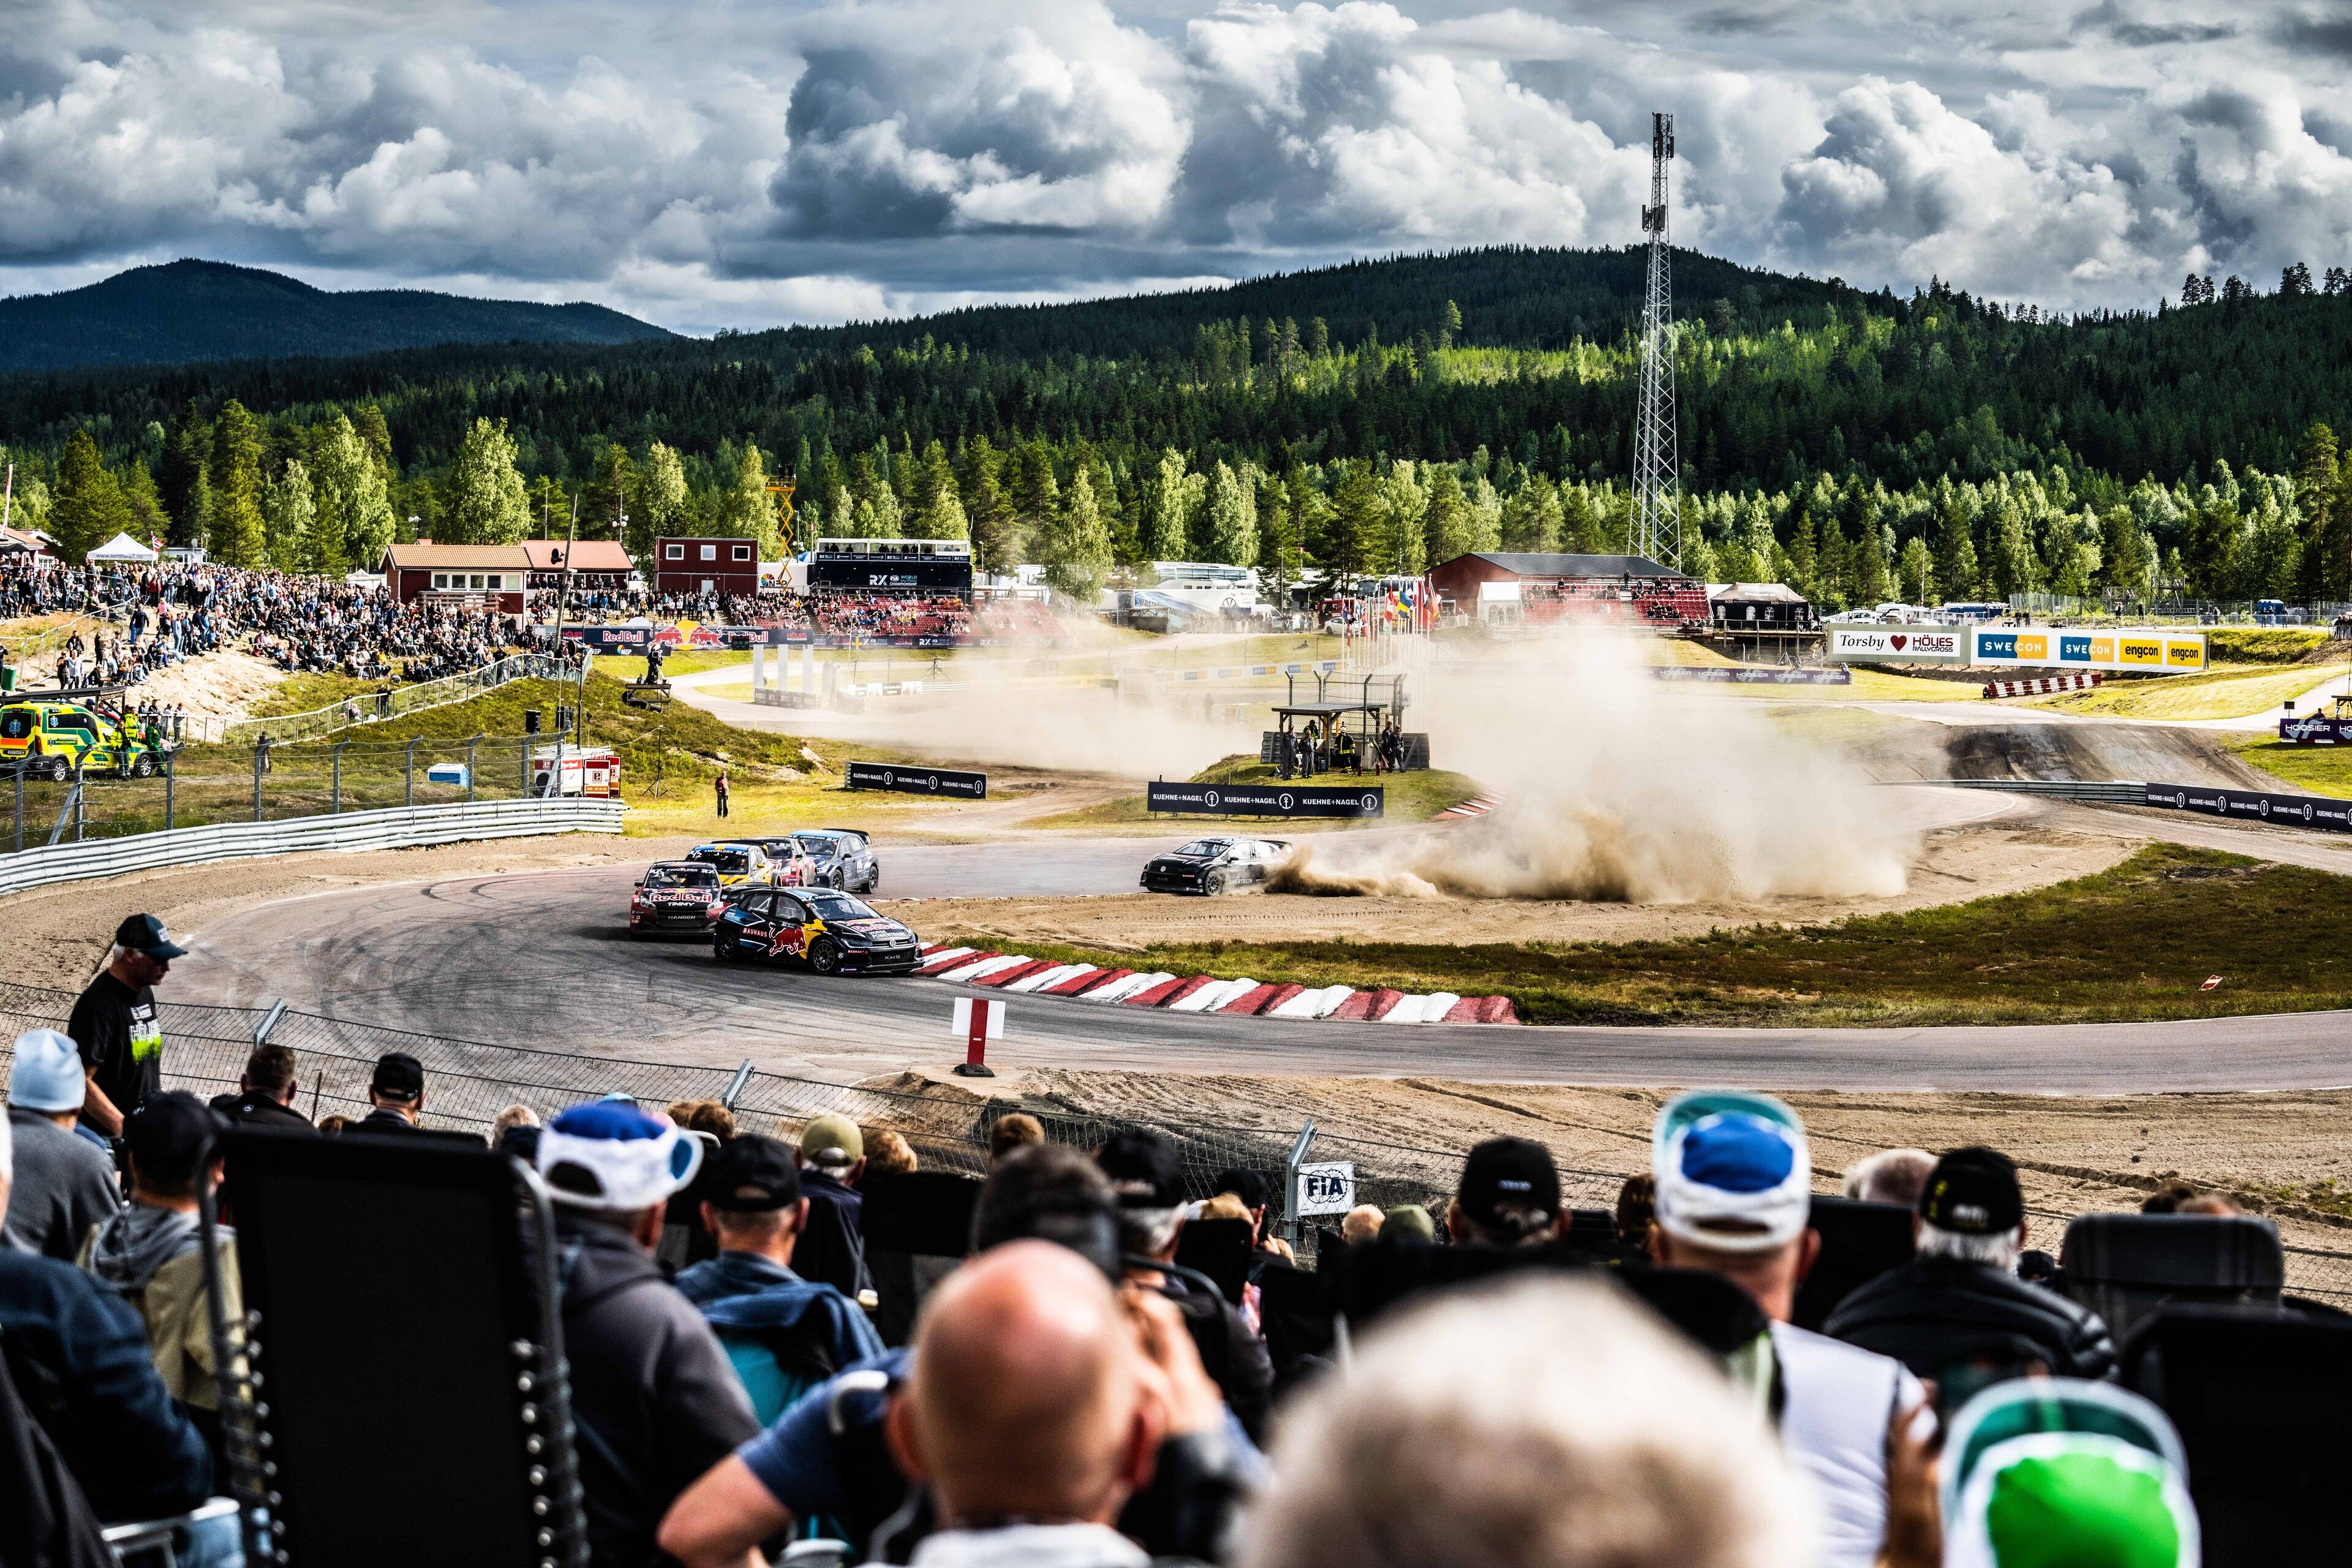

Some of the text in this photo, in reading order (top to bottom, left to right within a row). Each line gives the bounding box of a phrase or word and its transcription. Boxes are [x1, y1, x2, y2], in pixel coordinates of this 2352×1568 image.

[869, 575, 888, 586] RX
[603, 631, 644, 643] Red Bull
[750, 631, 769, 643] Bull
[1913, 635, 1953, 648] HÖLJES
[1840, 635, 1885, 650] Torsby
[1985, 641, 2041, 652] SWECON
[2065, 644, 2110, 654] SWECON
[2125, 645, 2158, 657] engcon
[2171, 646, 2198, 660] engcon
[2148, 794, 2176, 803] KUEHNE+NAGEL
[2189, 798, 2217, 807] KUEHNE+NAGEL
[2230, 802, 2259, 810] KUEHNE+NAGEL
[2273, 806, 2302, 815] KUEHNE+NAGEL
[2317, 810, 2346, 819] KUEHNE+NAGEL
[650, 893, 681, 902] Red
[682, 893, 712, 903] Bull
[743, 928, 767, 937] BAUHAUS
